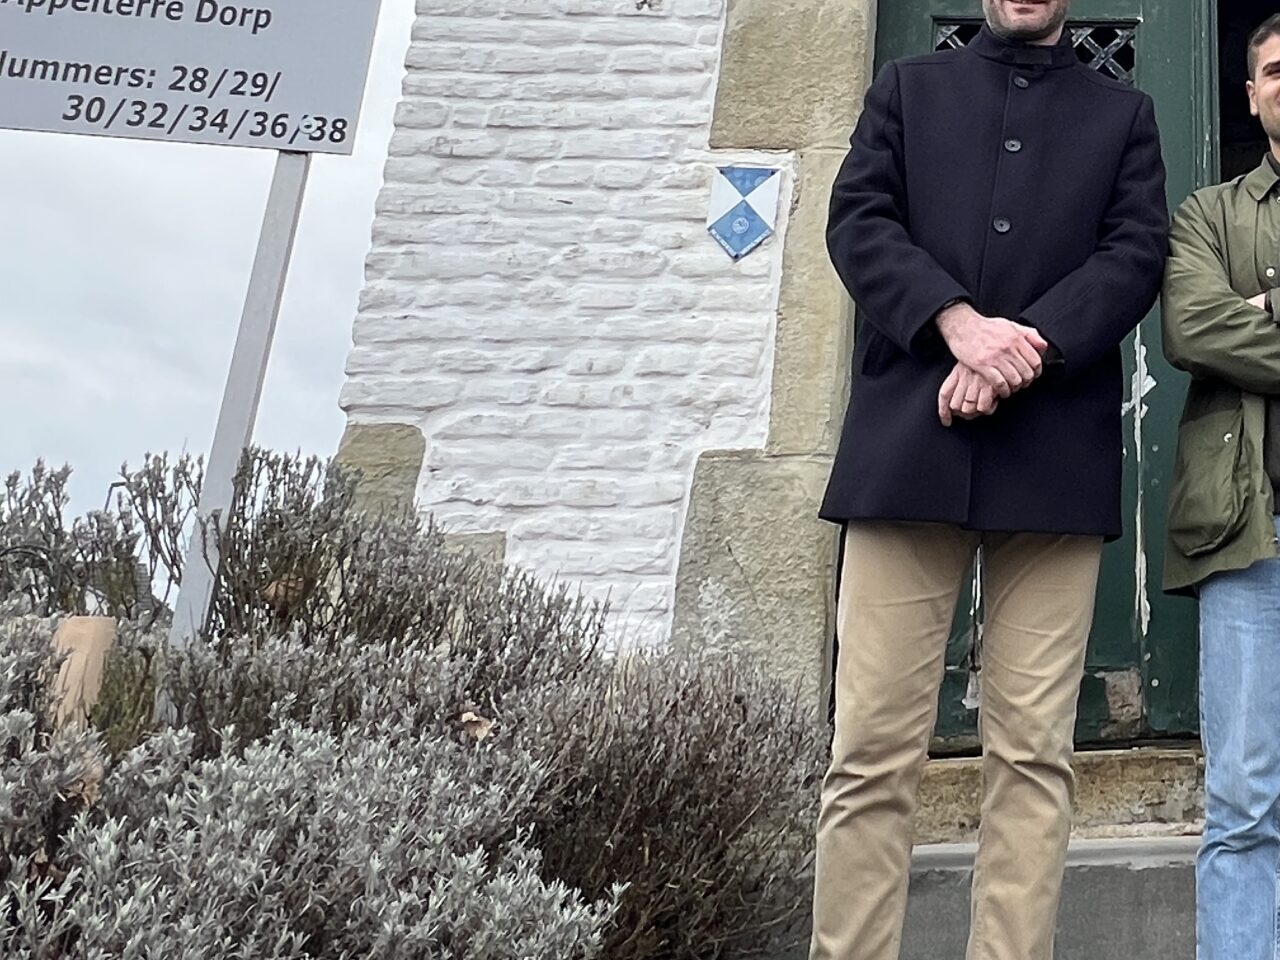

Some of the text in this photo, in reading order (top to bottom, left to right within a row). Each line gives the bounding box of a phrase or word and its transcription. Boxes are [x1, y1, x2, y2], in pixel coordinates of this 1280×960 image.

[0, 50, 282, 103] ummers: 28/29/
[62, 94, 349, 144] 30/32/34/36/38
